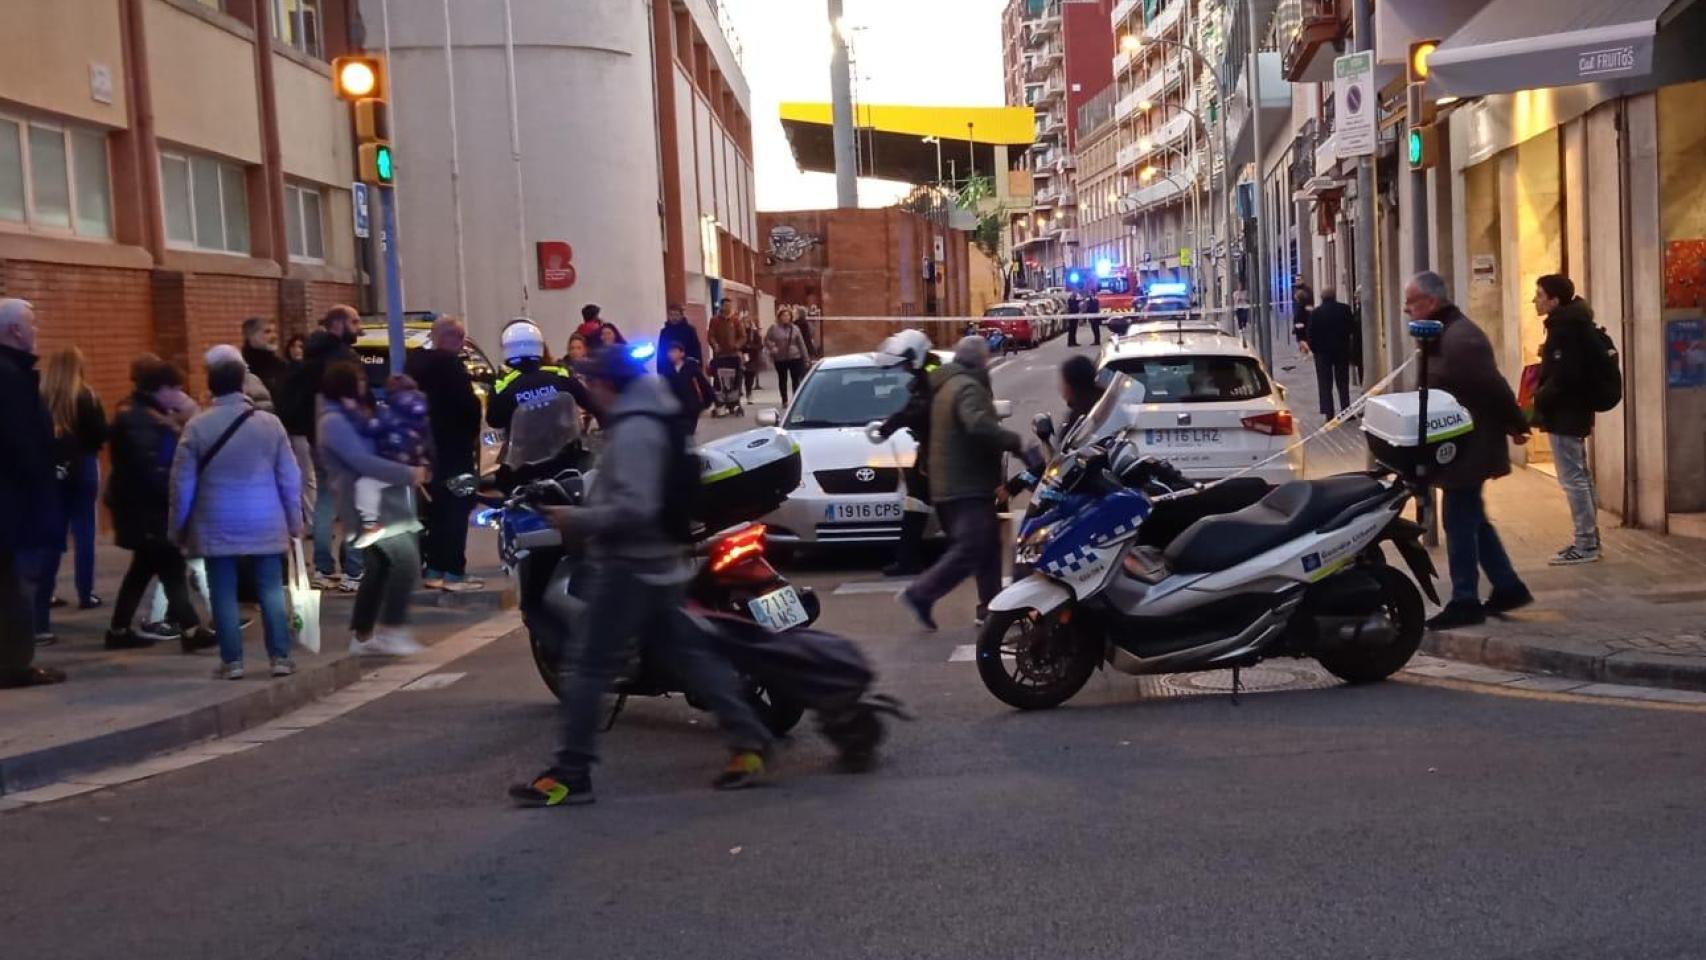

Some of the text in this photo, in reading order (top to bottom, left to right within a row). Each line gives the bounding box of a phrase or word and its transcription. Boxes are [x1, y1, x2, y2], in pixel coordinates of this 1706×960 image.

[360, 354, 384, 365] icia
[516, 385, 558, 402] POLICIA
[1155, 429, 1189, 443] 3116
[838, 503, 902, 518] 1916 CPS
[761, 589, 797, 615] 7113
[769, 607, 798, 629] LMS
